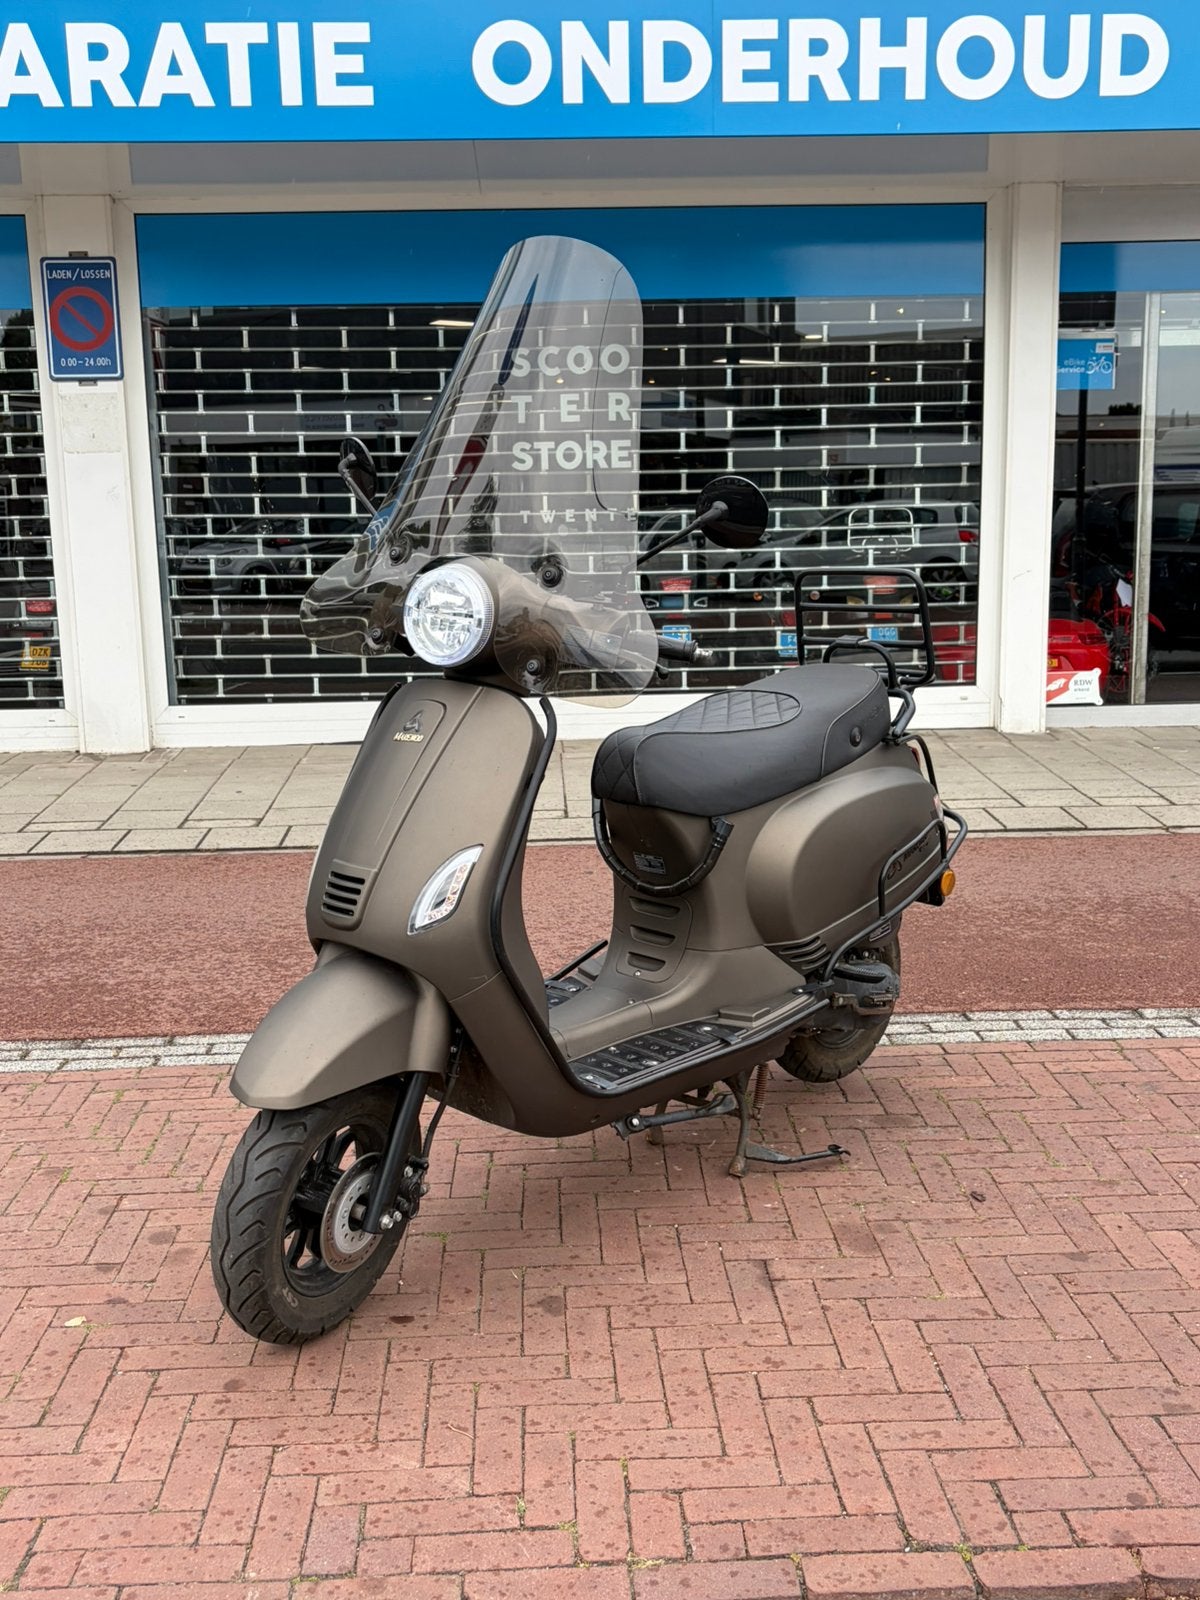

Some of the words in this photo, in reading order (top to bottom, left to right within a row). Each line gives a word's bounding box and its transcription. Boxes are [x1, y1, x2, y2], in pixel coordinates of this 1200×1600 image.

[0, 21, 375, 109] ARATIE
[471, 12, 1170, 106] ONDERHOUD
[511, 344, 630, 377] SCOO
[511, 440, 632, 471] STORE
